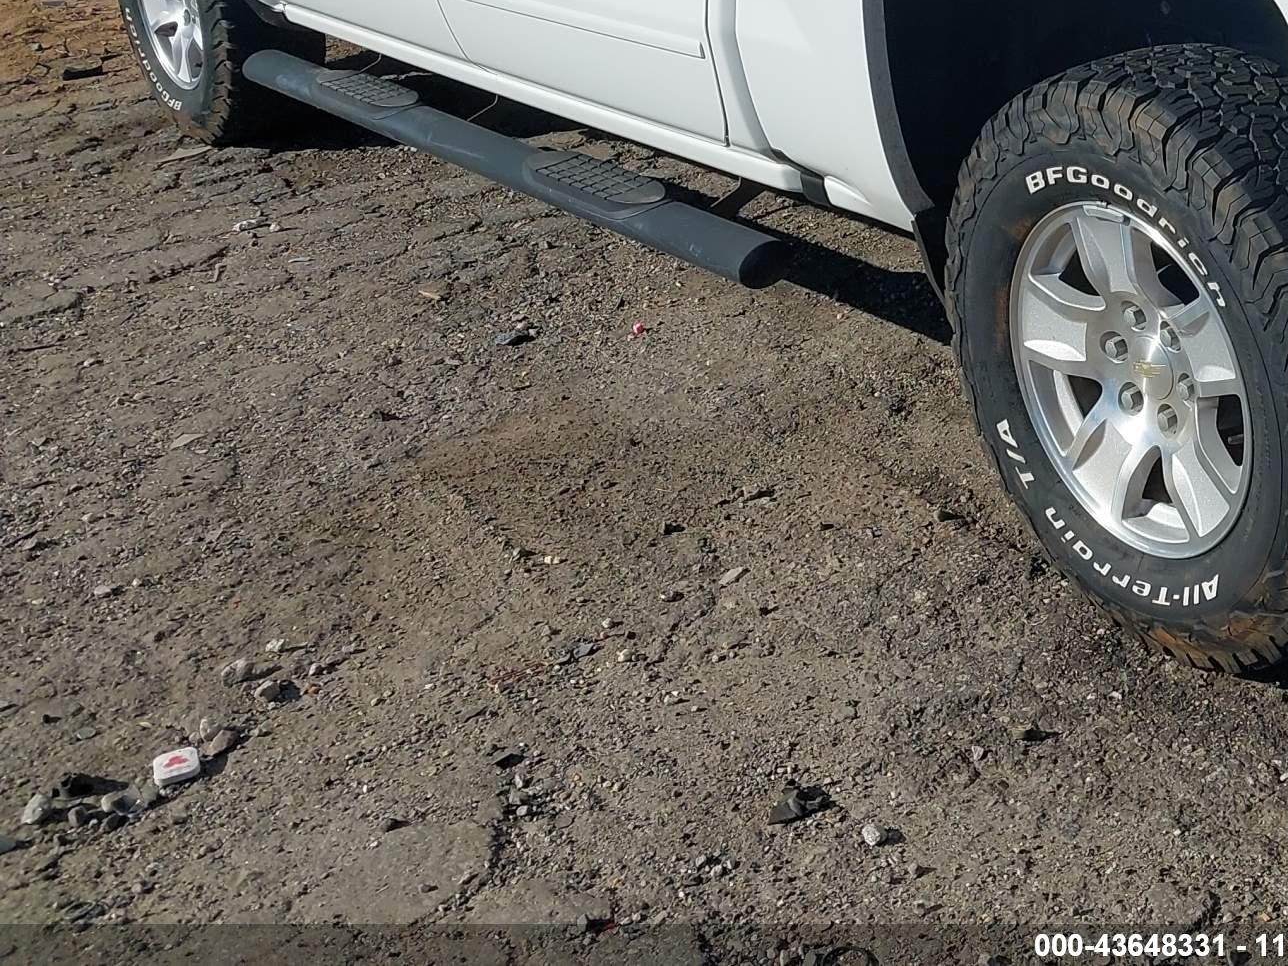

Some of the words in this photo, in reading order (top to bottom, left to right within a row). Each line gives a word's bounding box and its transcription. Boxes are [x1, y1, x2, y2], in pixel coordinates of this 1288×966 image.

[1025, 165, 1228, 309] BFGoodrich
[996, 418, 1036, 490] T/A
[1045, 505, 1221, 608] All-Terrain
